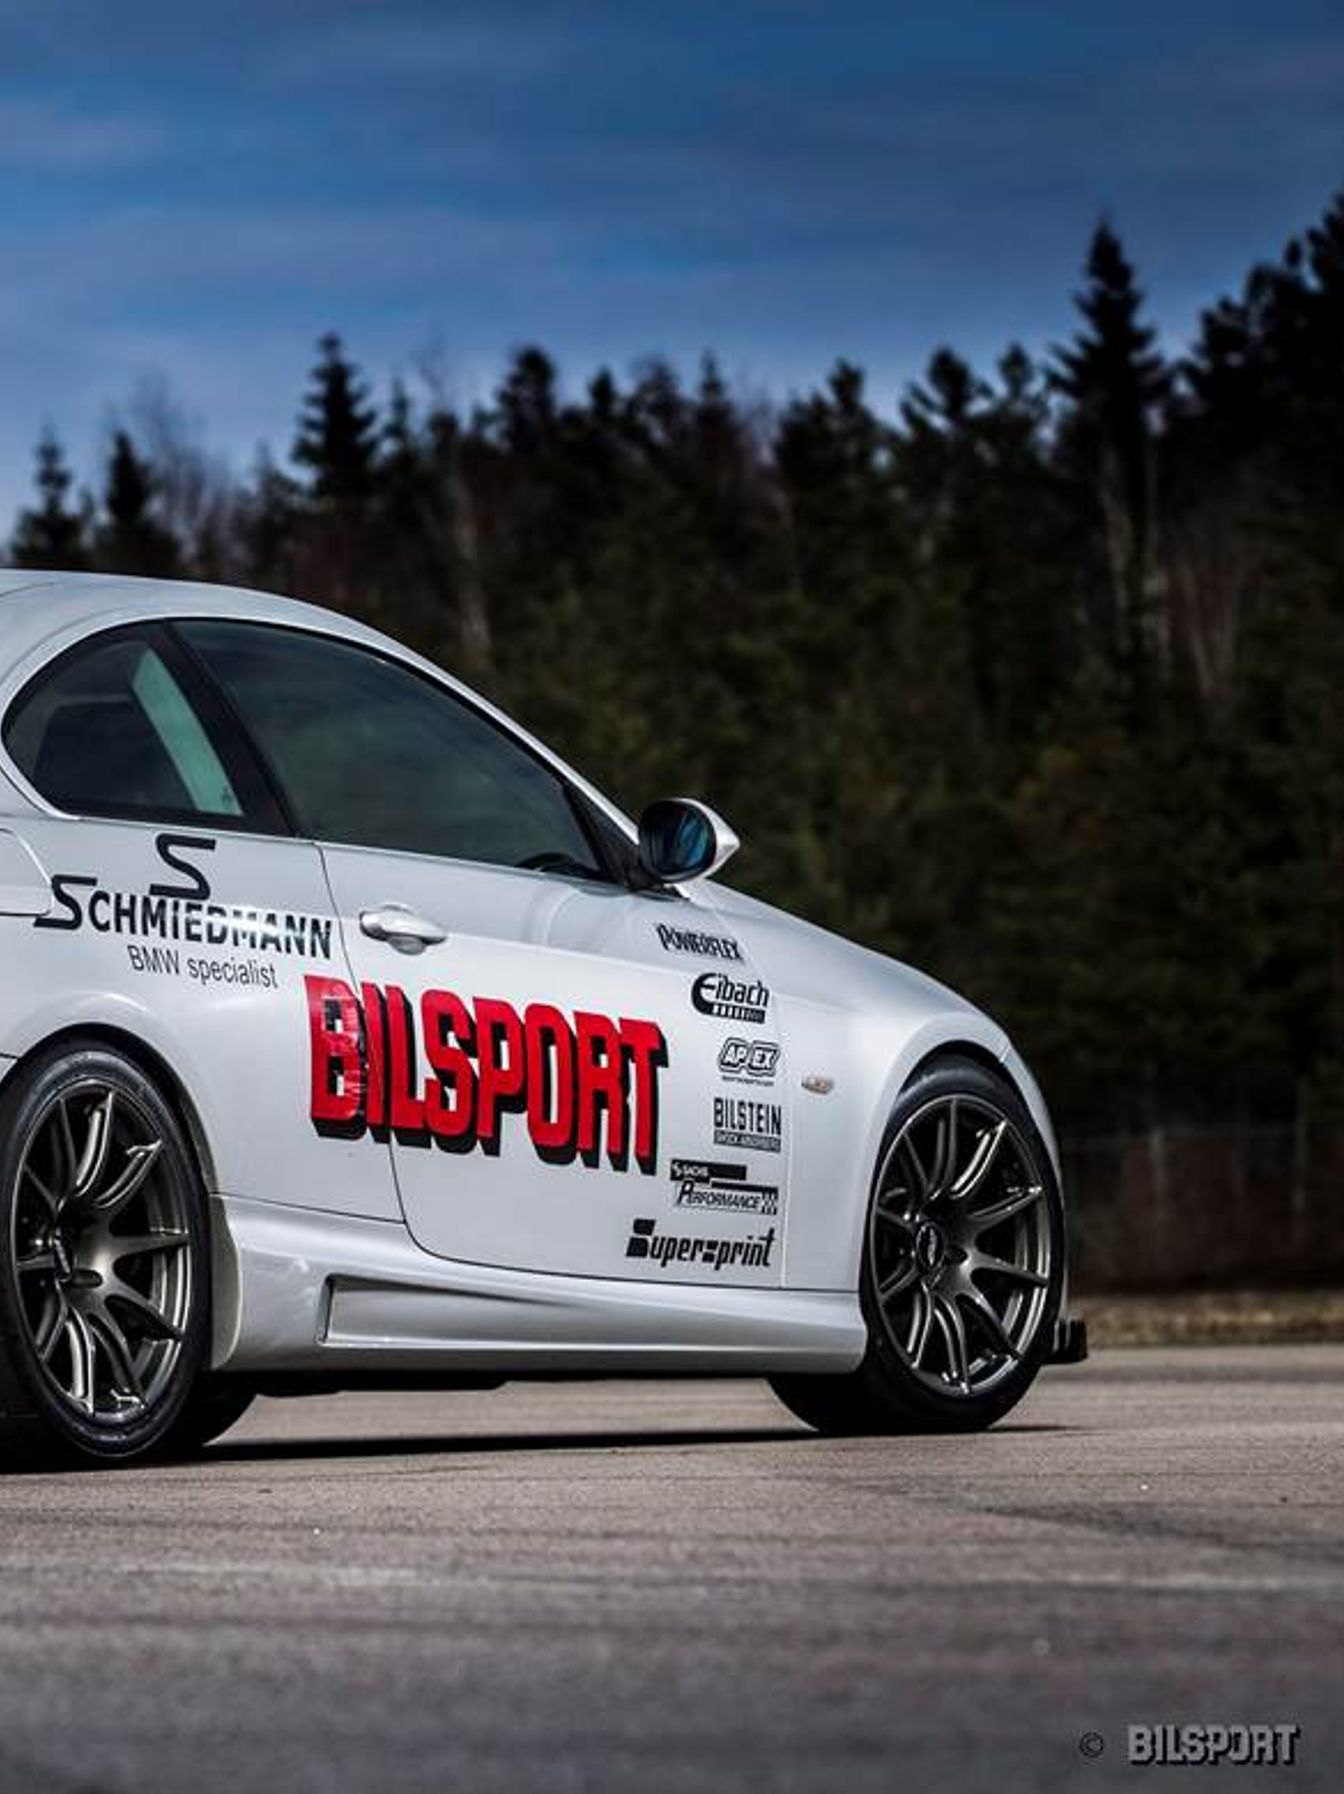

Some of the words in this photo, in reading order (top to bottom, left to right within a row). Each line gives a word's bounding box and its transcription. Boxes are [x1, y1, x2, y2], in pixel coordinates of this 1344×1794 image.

[33, 874, 332, 959] SCHMIEDMANN
[127, 945, 180, 976] BMW
[187, 955, 278, 989] specialist
[691, 972, 770, 1017] Eibach
[304, 975, 669, 1177] BILSPORT
[714, 1096, 781, 1136] BILSTEIN
[676, 1180, 761, 1209] PERFORMANCE
[626, 1218, 776, 1271] Supersprint
